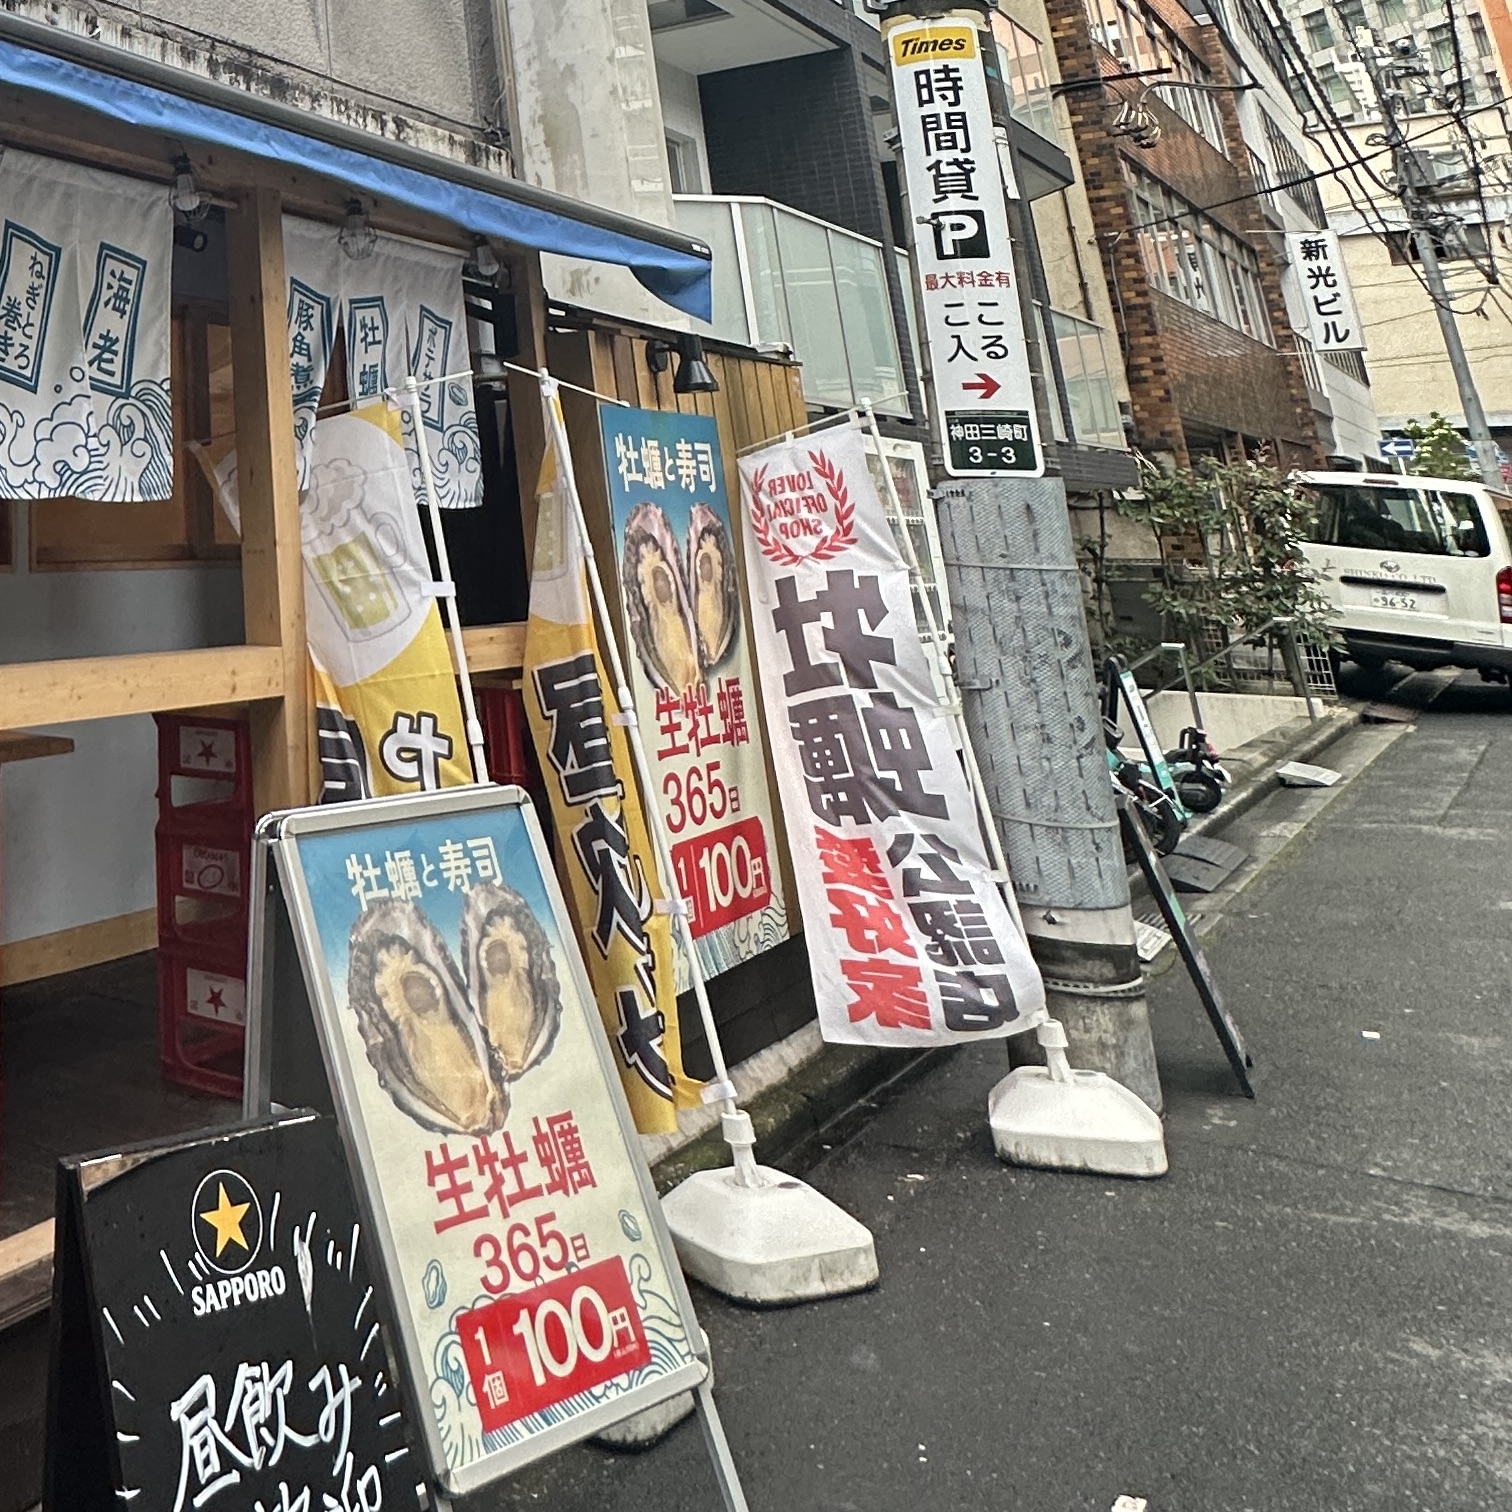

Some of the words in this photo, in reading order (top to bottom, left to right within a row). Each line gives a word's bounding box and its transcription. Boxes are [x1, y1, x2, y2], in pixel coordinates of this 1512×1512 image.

[901, 36, 967, 58] Times
[914, 64, 980, 204] 時間貸
[940, 213, 979, 256] P
[13, 251, 46, 371] ねぎとろ
[925, 270, 1011, 292] 最大料金有
[944, 301, 1005, 327] ここ
[1299, 238, 1350, 345] 新光ビル
[87, 267, 134, 378] 海老
[947, 334, 1009, 363] 入る
[614, 432, 717, 494] 牡蠣と寿司
[949, 422, 1028, 441] 神田三崎町
[969, 446, 1017, 464] 3-3
[655, 676, 750, 762] 生牡蠣
[662, 760, 741, 834] 365日
[345, 836, 503, 912] 牡蠣と寿司
[699, 834, 767, 913] 100円
[425, 1110, 598, 1235] 生牡蠣
[191, 1265, 286, 1316] SAPPORO
[473, 1211, 590, 1294] 365日
[513, 1285, 636, 1387] 100円
[169, 1359, 362, 1512] 昼飲み
